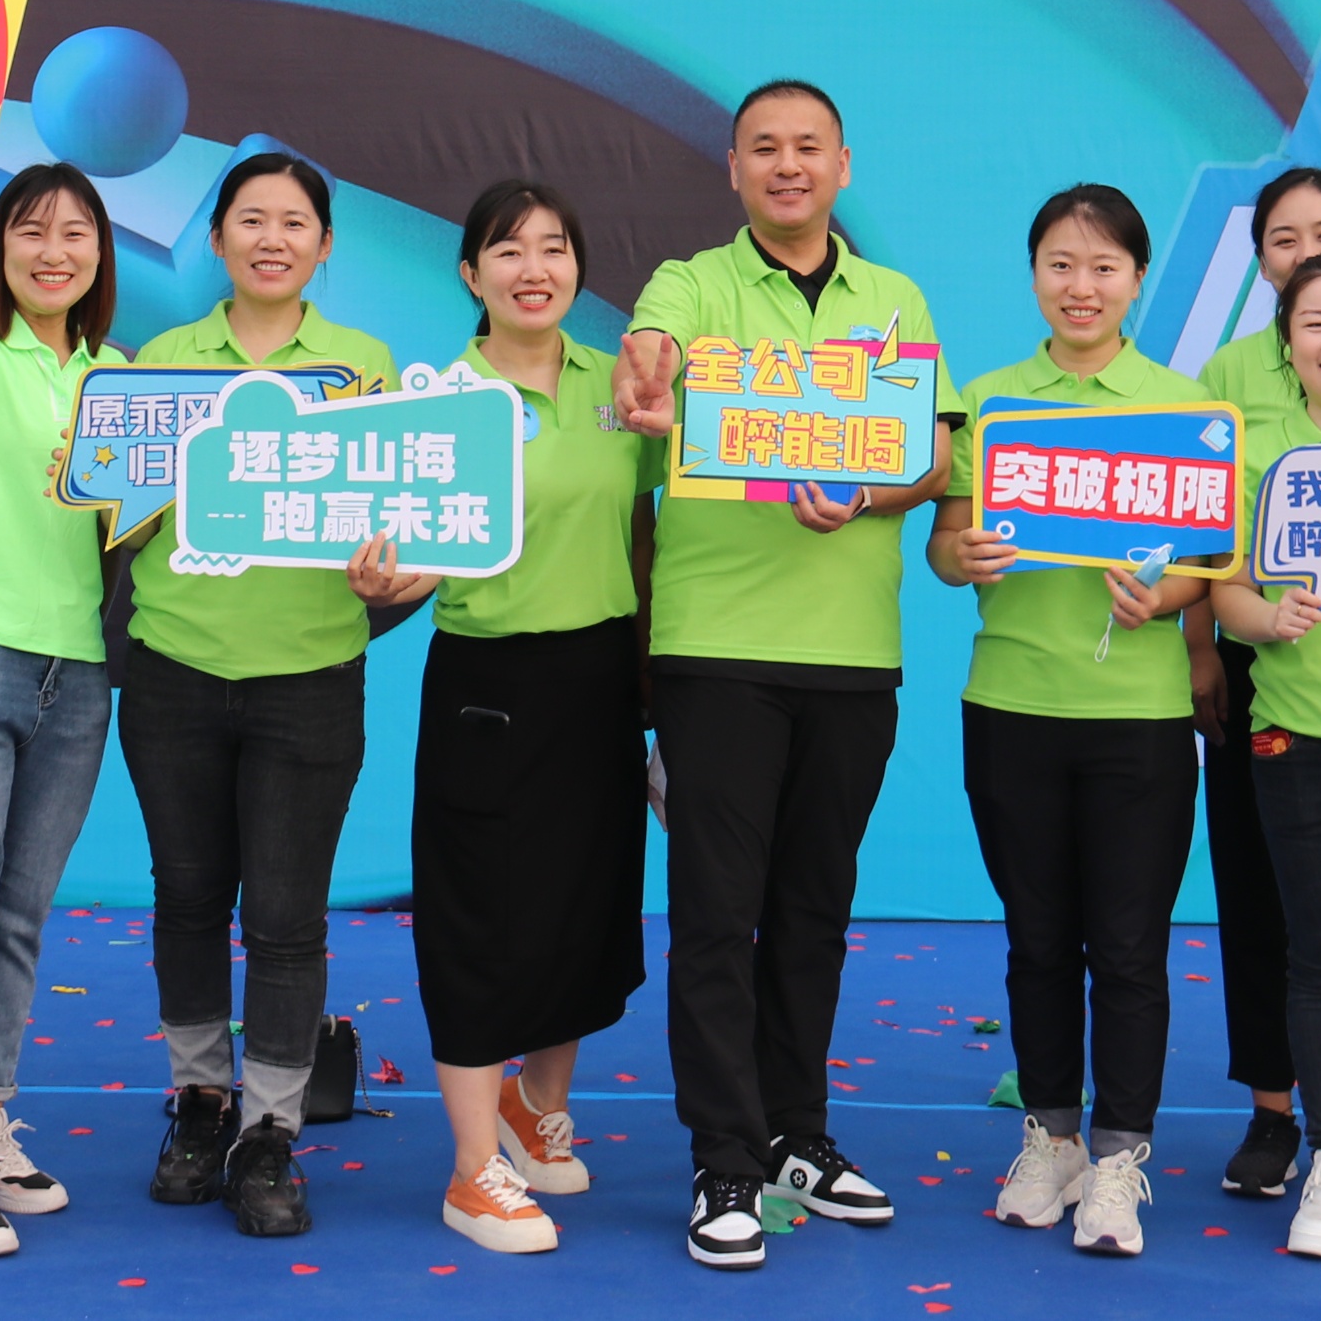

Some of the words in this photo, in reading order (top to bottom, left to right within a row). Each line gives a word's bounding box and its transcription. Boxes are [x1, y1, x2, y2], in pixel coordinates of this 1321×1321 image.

[683, 334, 870, 402] 全公司
[229, 431, 457, 484] 逐梦山海
[718, 406, 907, 476] 醉能喝
[262, 491, 491, 545] 跑赢未来
[990, 449, 1231, 522] 突破极限
